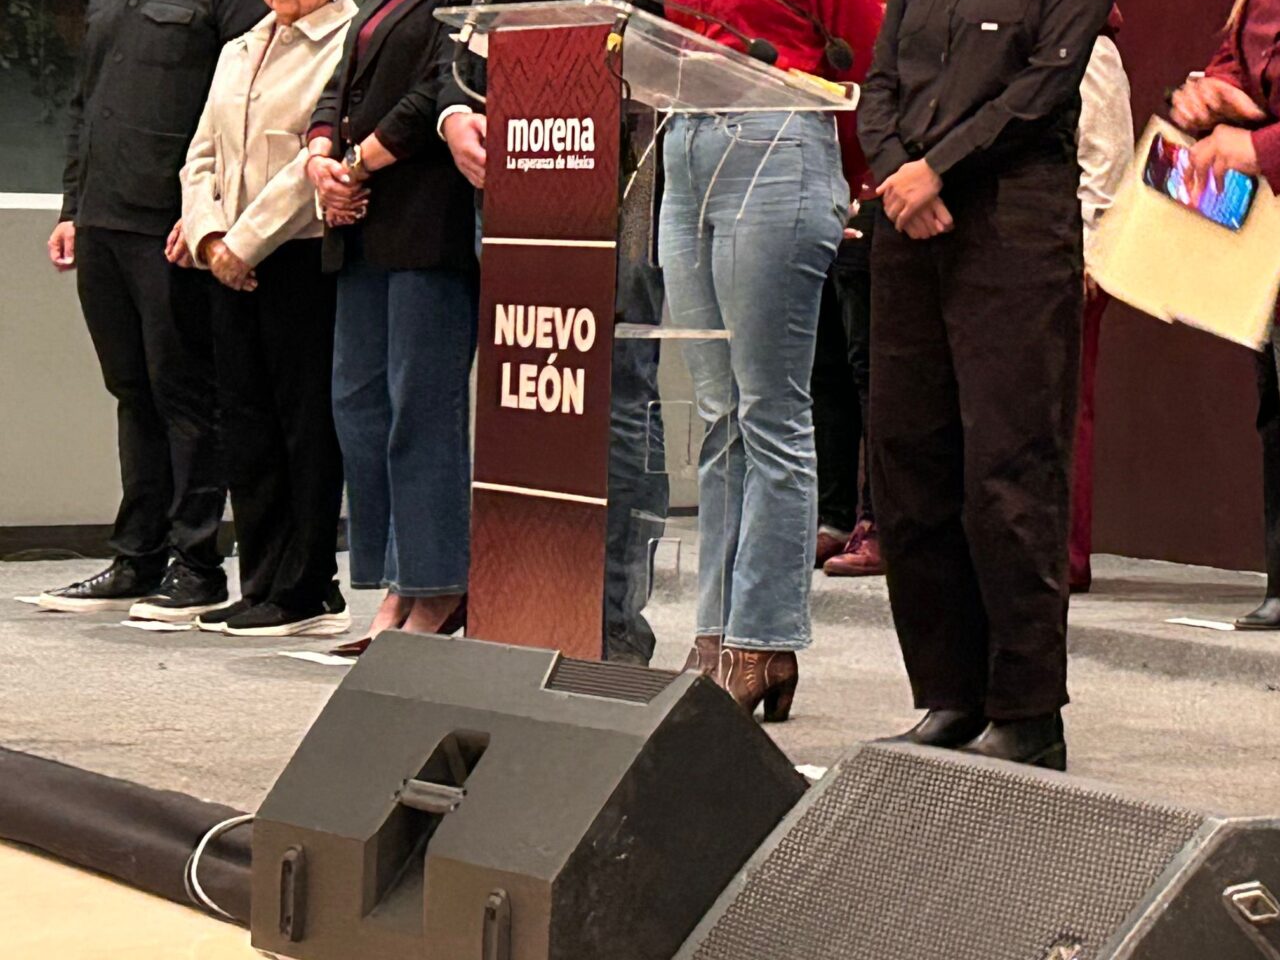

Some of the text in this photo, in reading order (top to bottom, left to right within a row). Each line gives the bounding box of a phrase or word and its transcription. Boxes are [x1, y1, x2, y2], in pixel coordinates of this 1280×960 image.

[507, 117, 595, 152] morena
[506, 155, 516, 169] La
[494, 303, 596, 352] NUEVO
[501, 352, 585, 415] LEÓN
